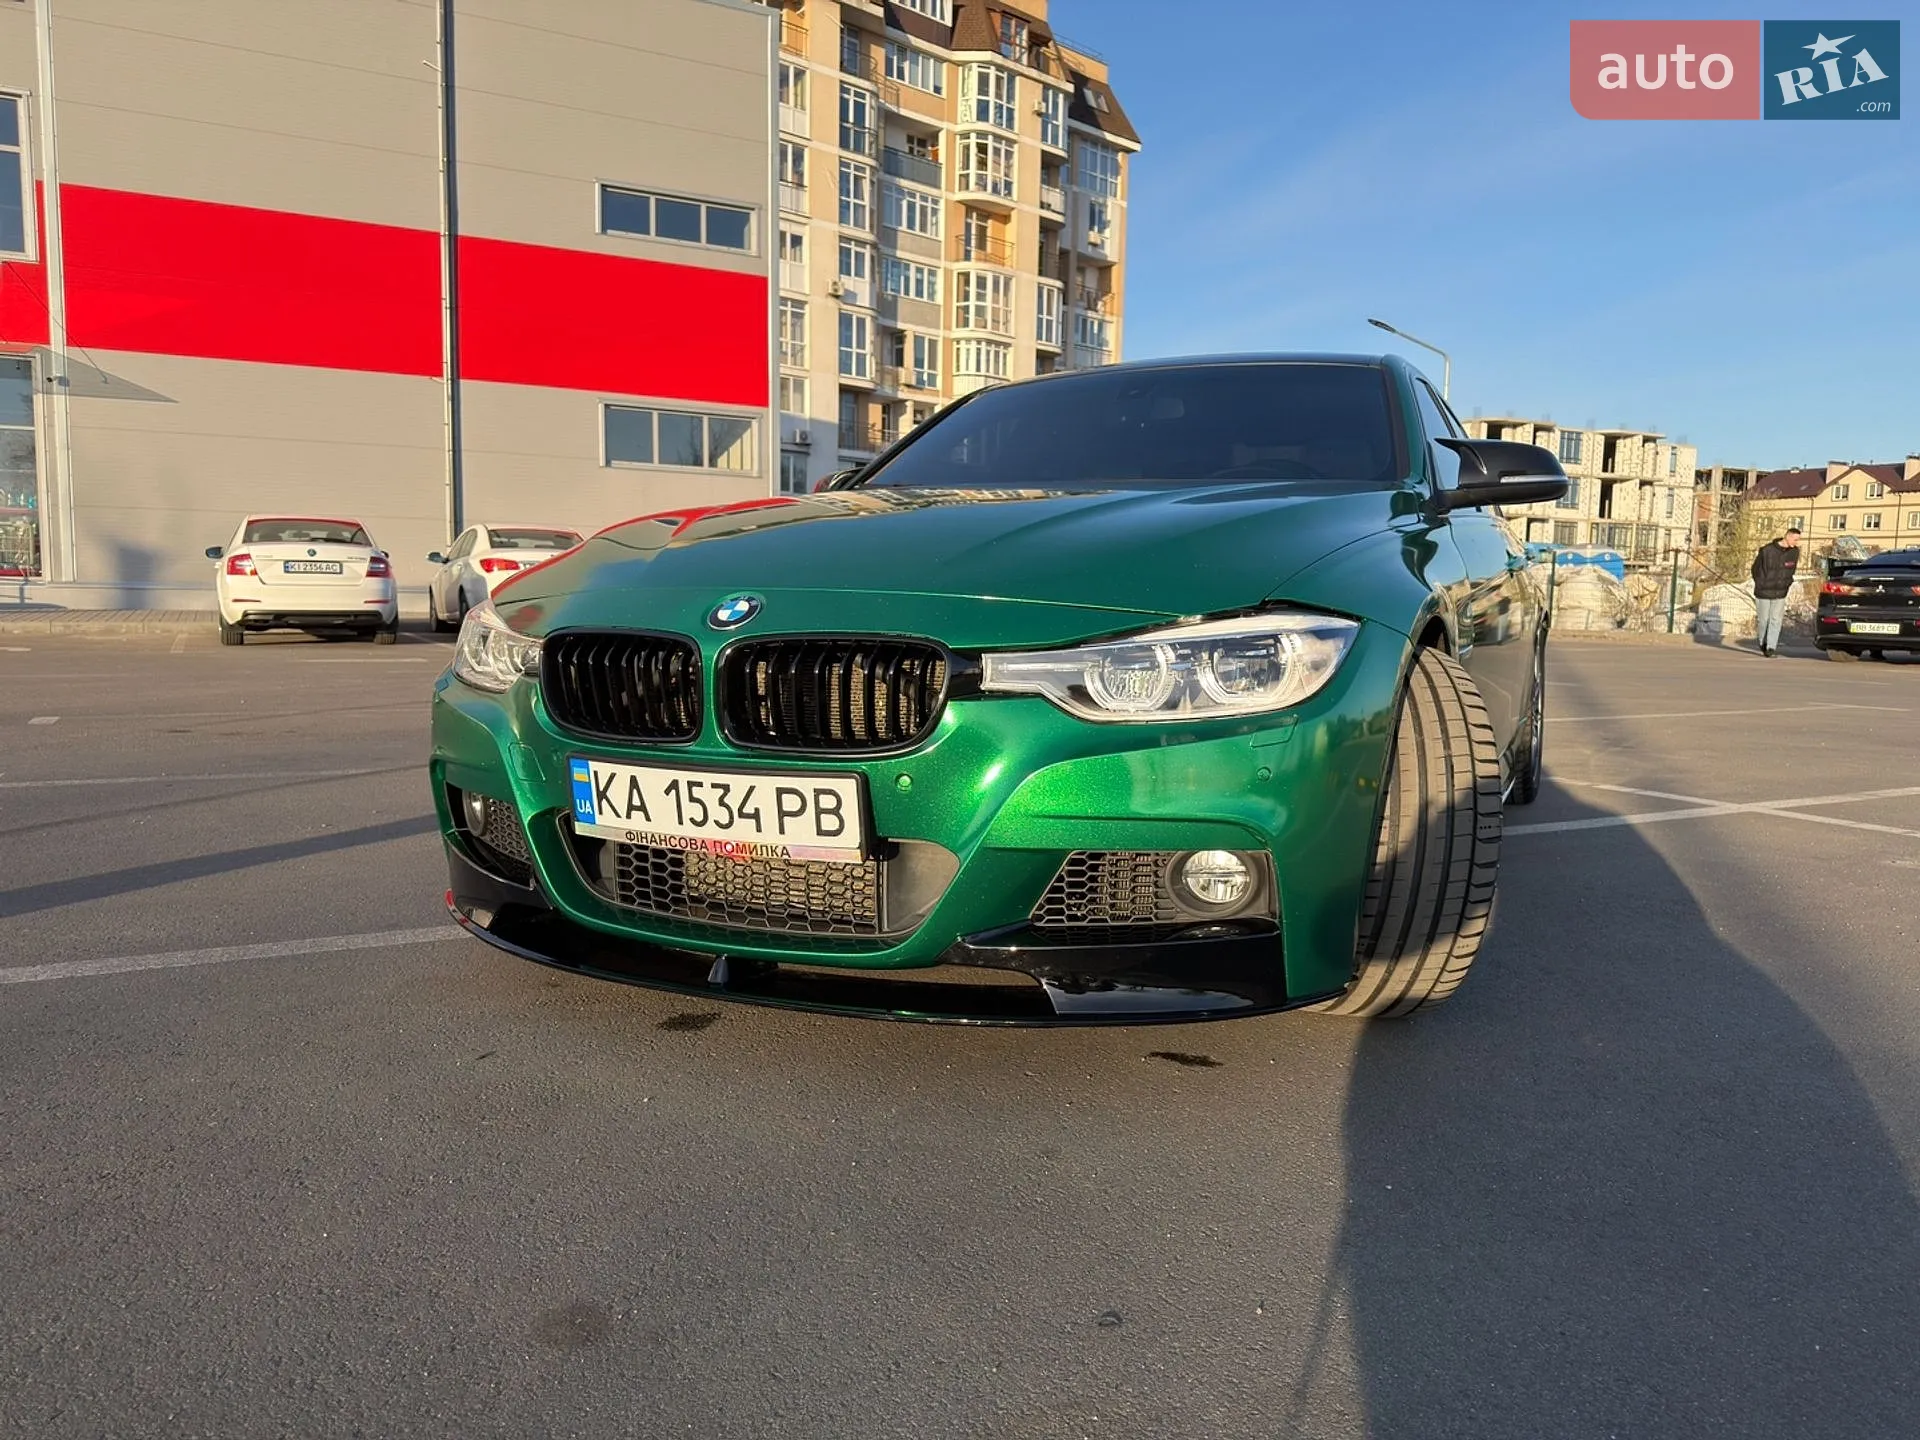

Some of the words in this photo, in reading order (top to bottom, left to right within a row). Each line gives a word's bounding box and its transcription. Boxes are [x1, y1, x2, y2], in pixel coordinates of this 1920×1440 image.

[576, 798, 593, 814] UA
[594, 770, 652, 822] KA
[664, 778, 762, 833] 1534
[775, 786, 845, 837] PB
[625, 831, 709, 851] ФІНАНСОВА
[713, 839, 791, 859] ПОМИЛКА
